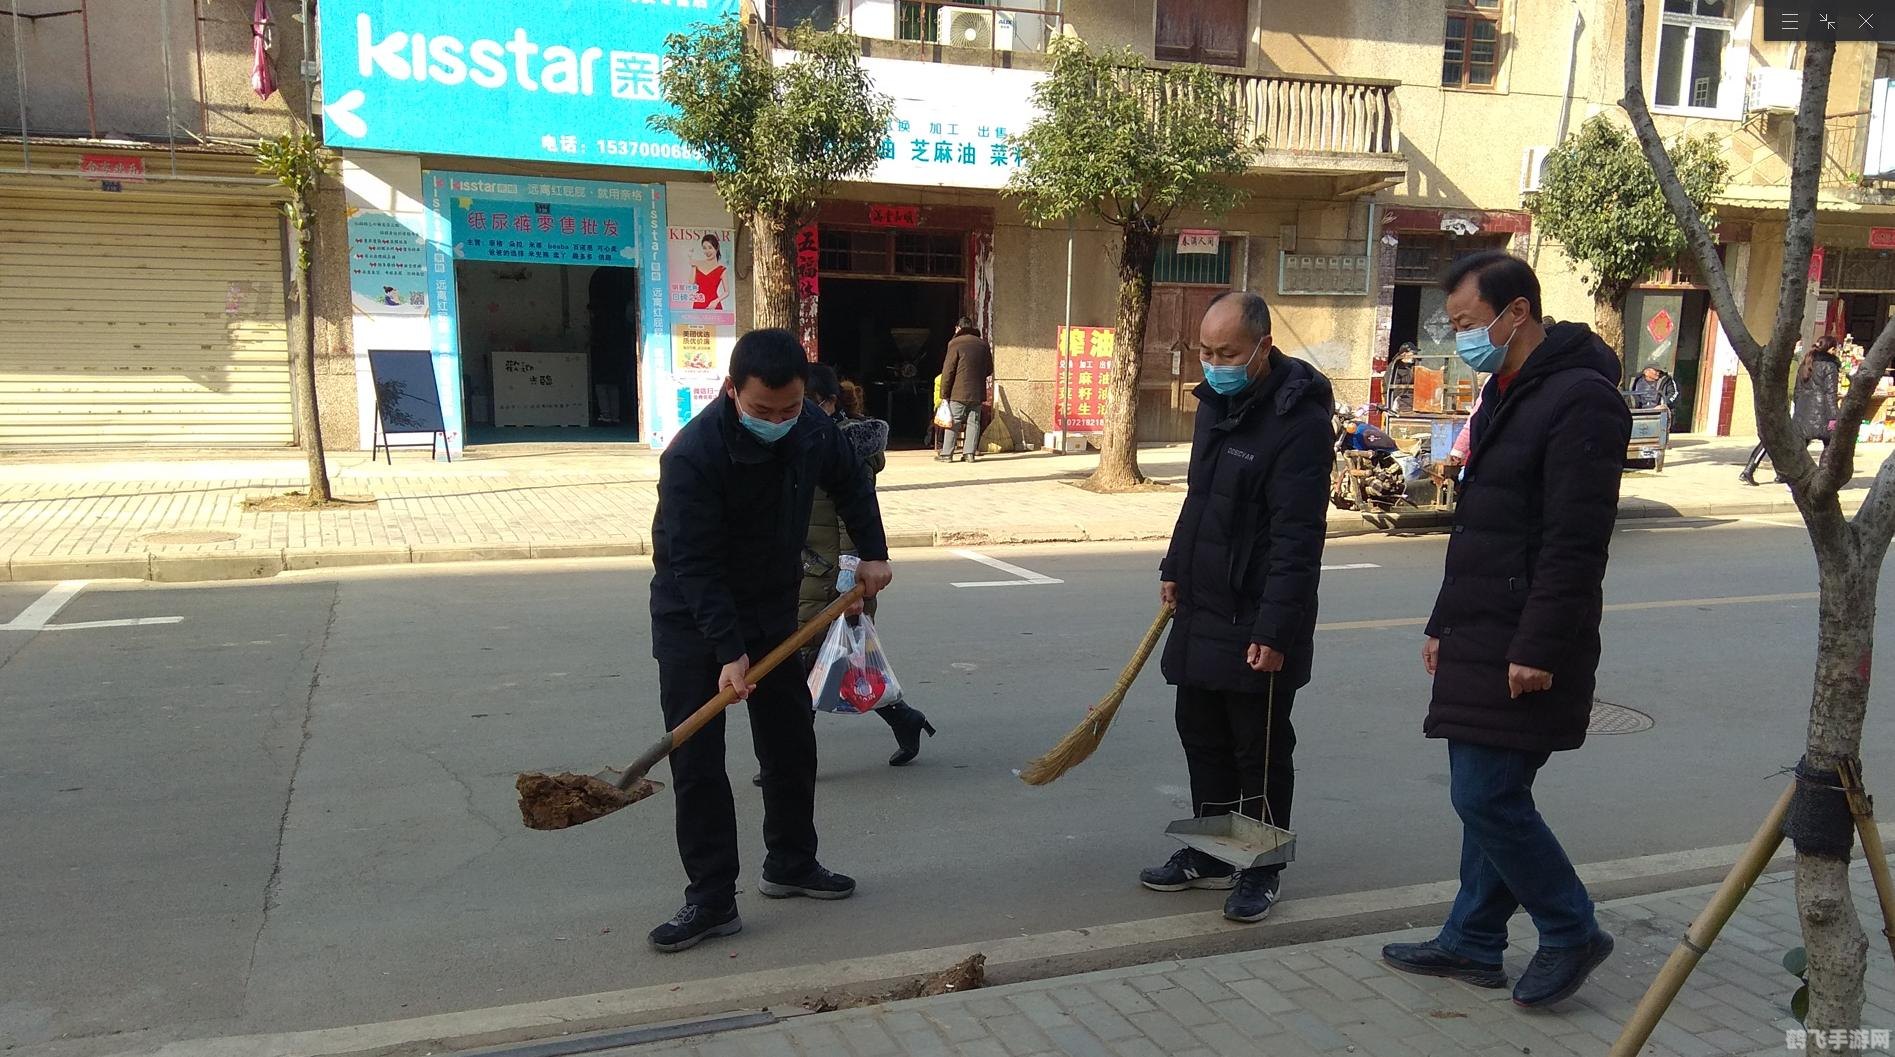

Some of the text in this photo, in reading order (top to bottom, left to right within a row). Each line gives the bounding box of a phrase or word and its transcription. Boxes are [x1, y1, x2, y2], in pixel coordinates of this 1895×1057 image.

[356, 12, 602, 97] kisstar
[929, 122, 960, 135] 加工
[977, 125, 1007, 139] 出售
[911, 139, 976, 165] 芝麻油
[467, 211, 619, 237] 纸尿裤零售批发
[682, 330, 710, 338] 美团优选
[1079, 360, 1093, 369] 加工
